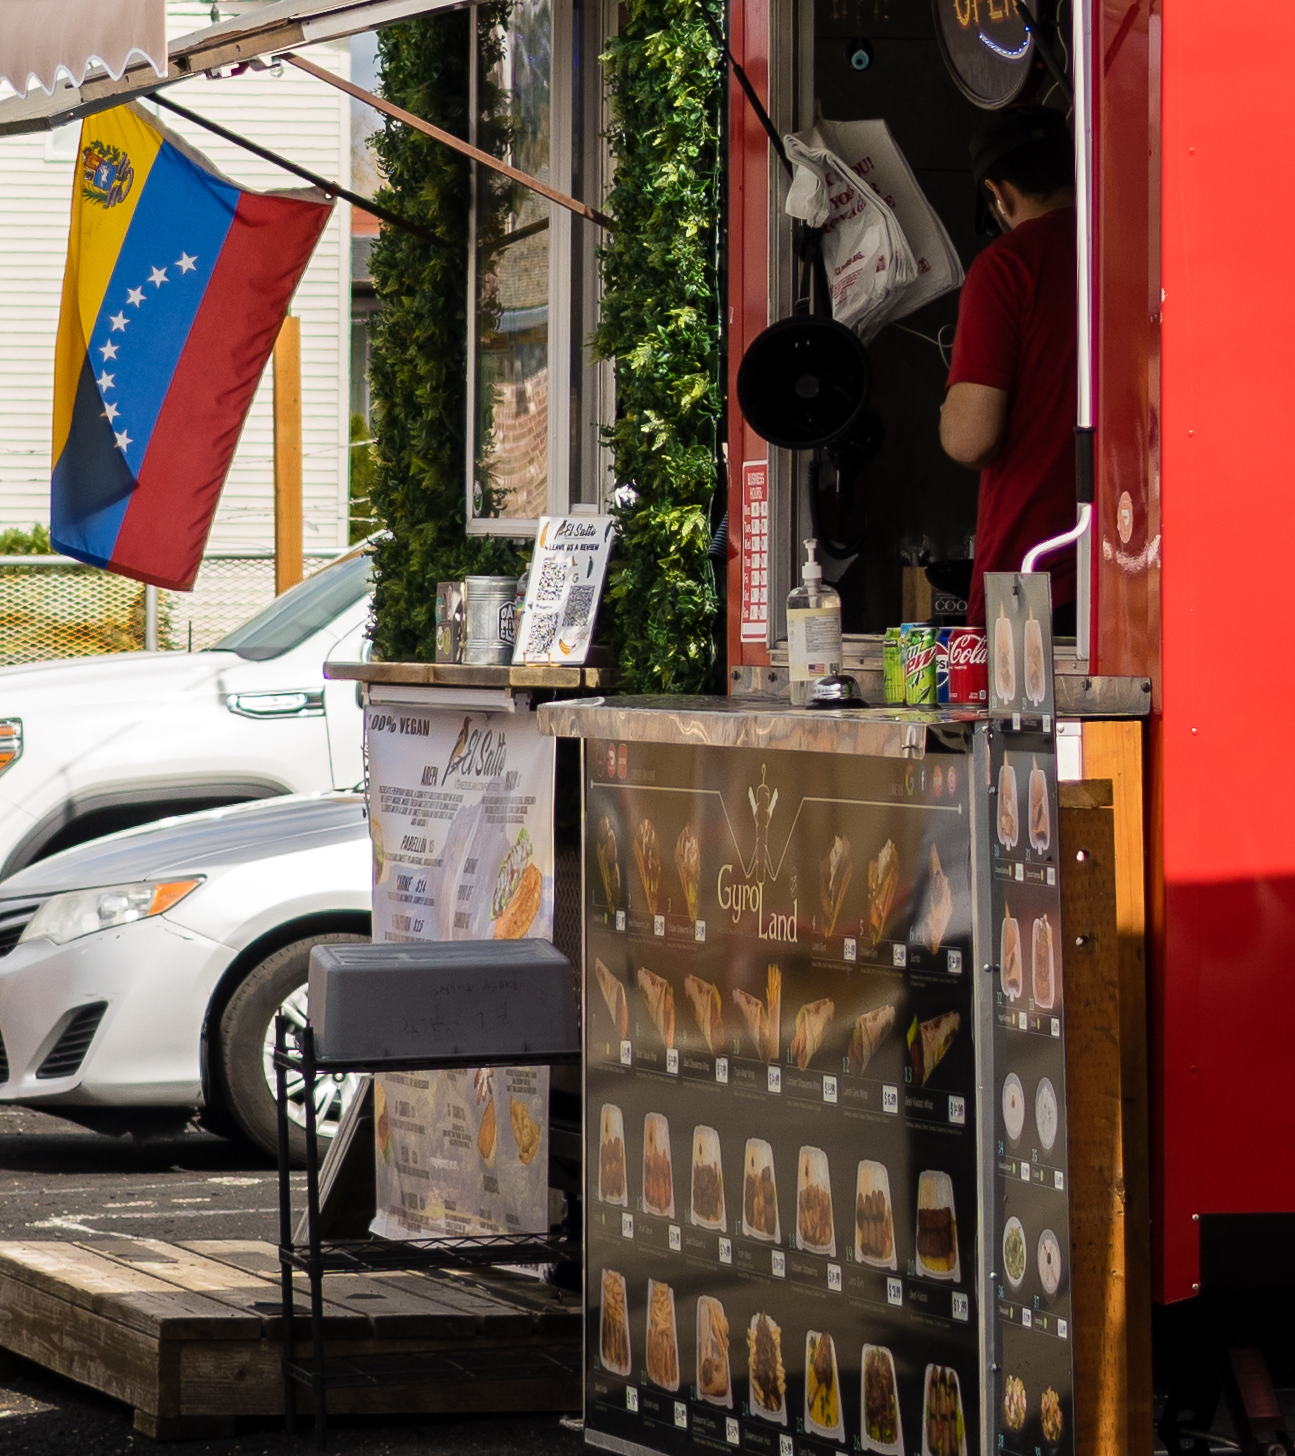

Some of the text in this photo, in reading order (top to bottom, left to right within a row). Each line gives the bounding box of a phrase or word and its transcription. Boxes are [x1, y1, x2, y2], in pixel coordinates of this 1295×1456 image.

[950, 635, 988, 664] Cola
[399, 717, 430, 737] VEGAN
[717, 864, 760, 924] Gyro
[757, 882, 798, 943] Land
[904, 1067, 912, 1083] 13
